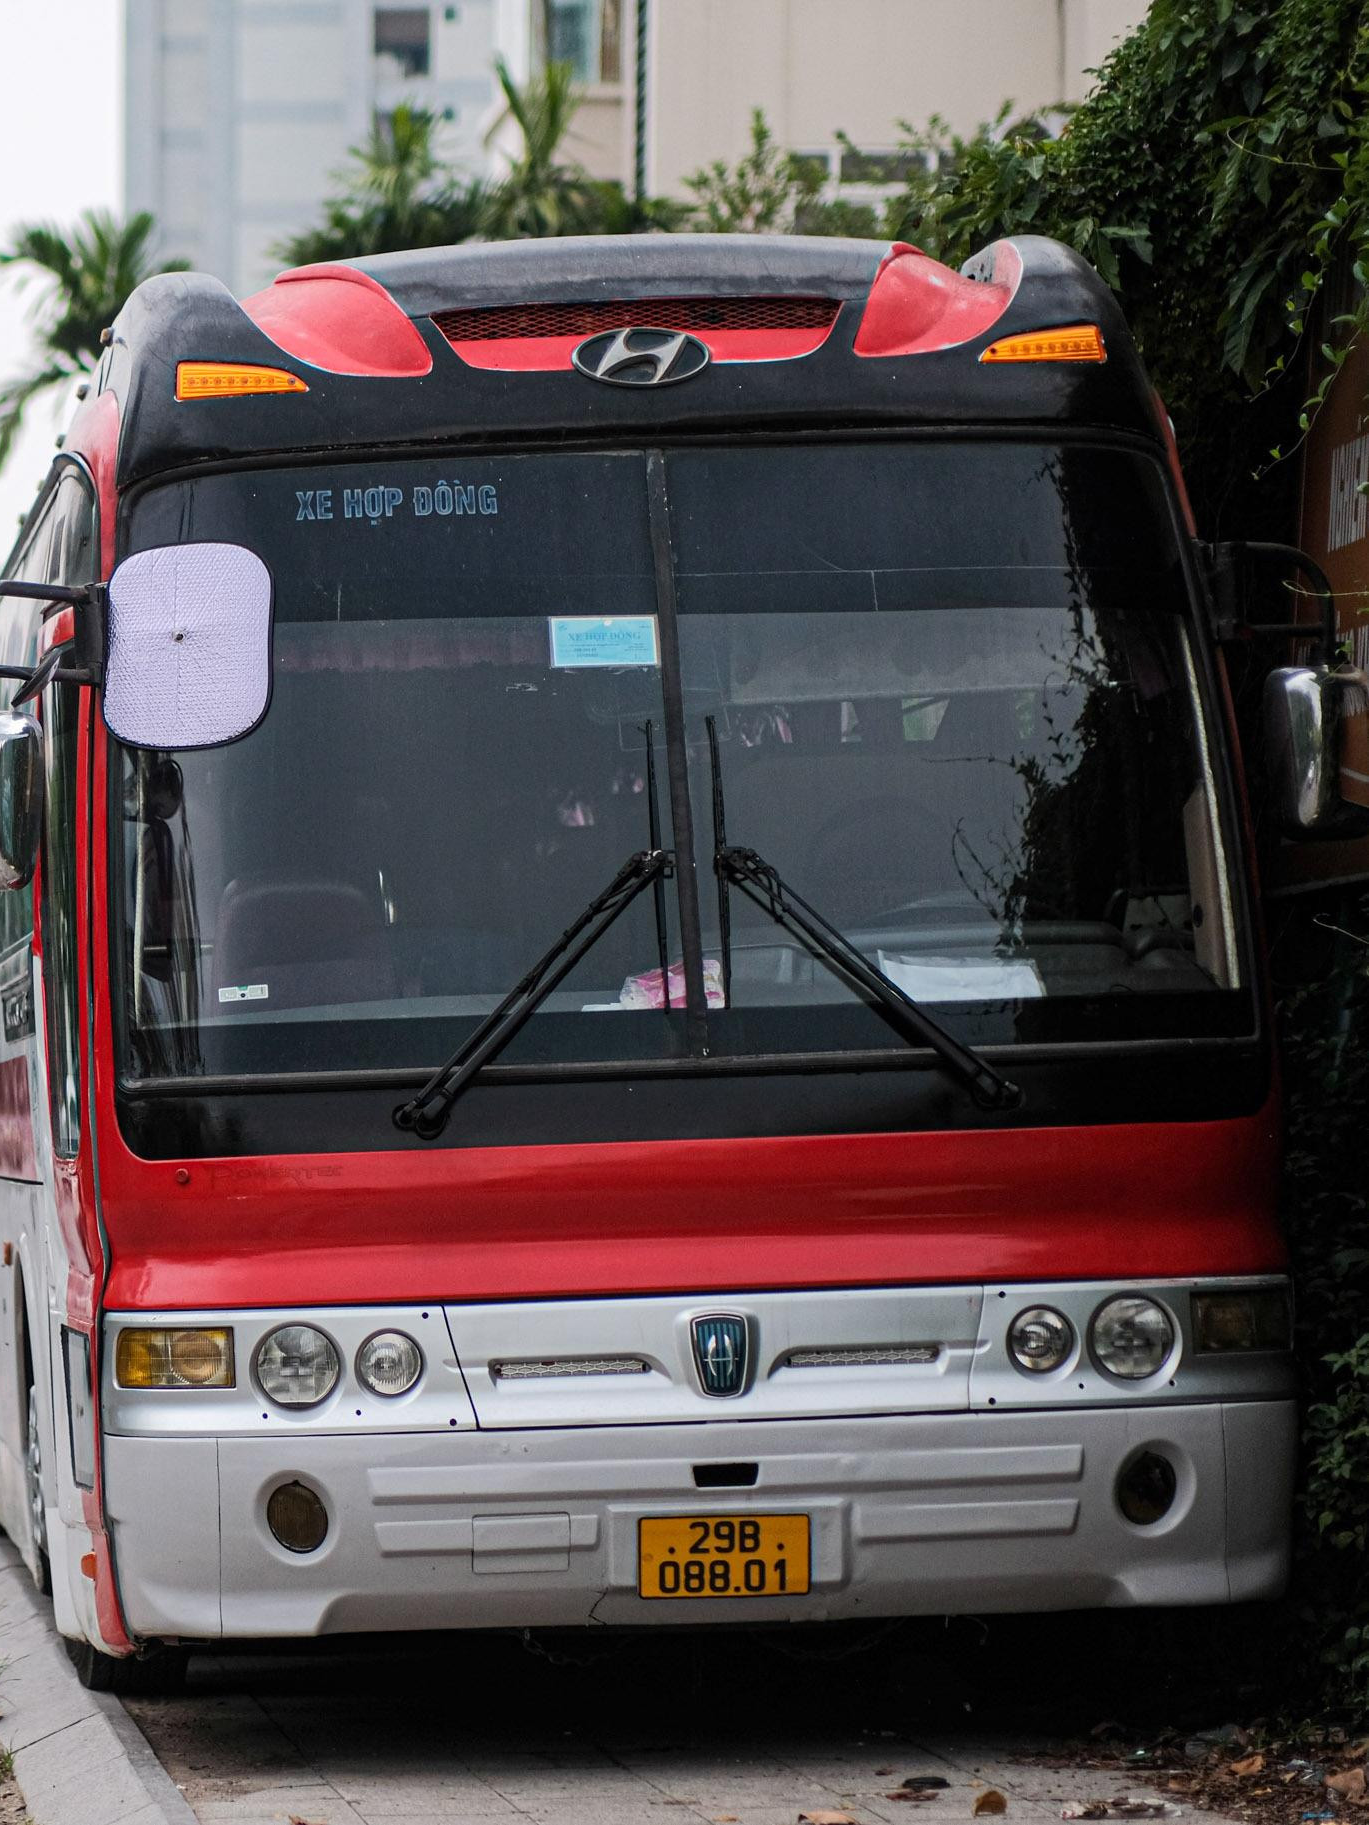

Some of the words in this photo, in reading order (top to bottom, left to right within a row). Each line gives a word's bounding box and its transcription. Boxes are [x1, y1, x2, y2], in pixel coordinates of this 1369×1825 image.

[295, 490, 333, 521] XE
[343, 485, 403, 526] HỢP
[412, 479, 498, 516] ĐỒNG
[568, 632, 583, 642] XE
[585, 631, 608, 642] HỢP
[610, 630, 641, 640] ĐỒNG
[689, 1520, 760, 1554] 29B
[659, 1559, 786, 1593] 088.01
